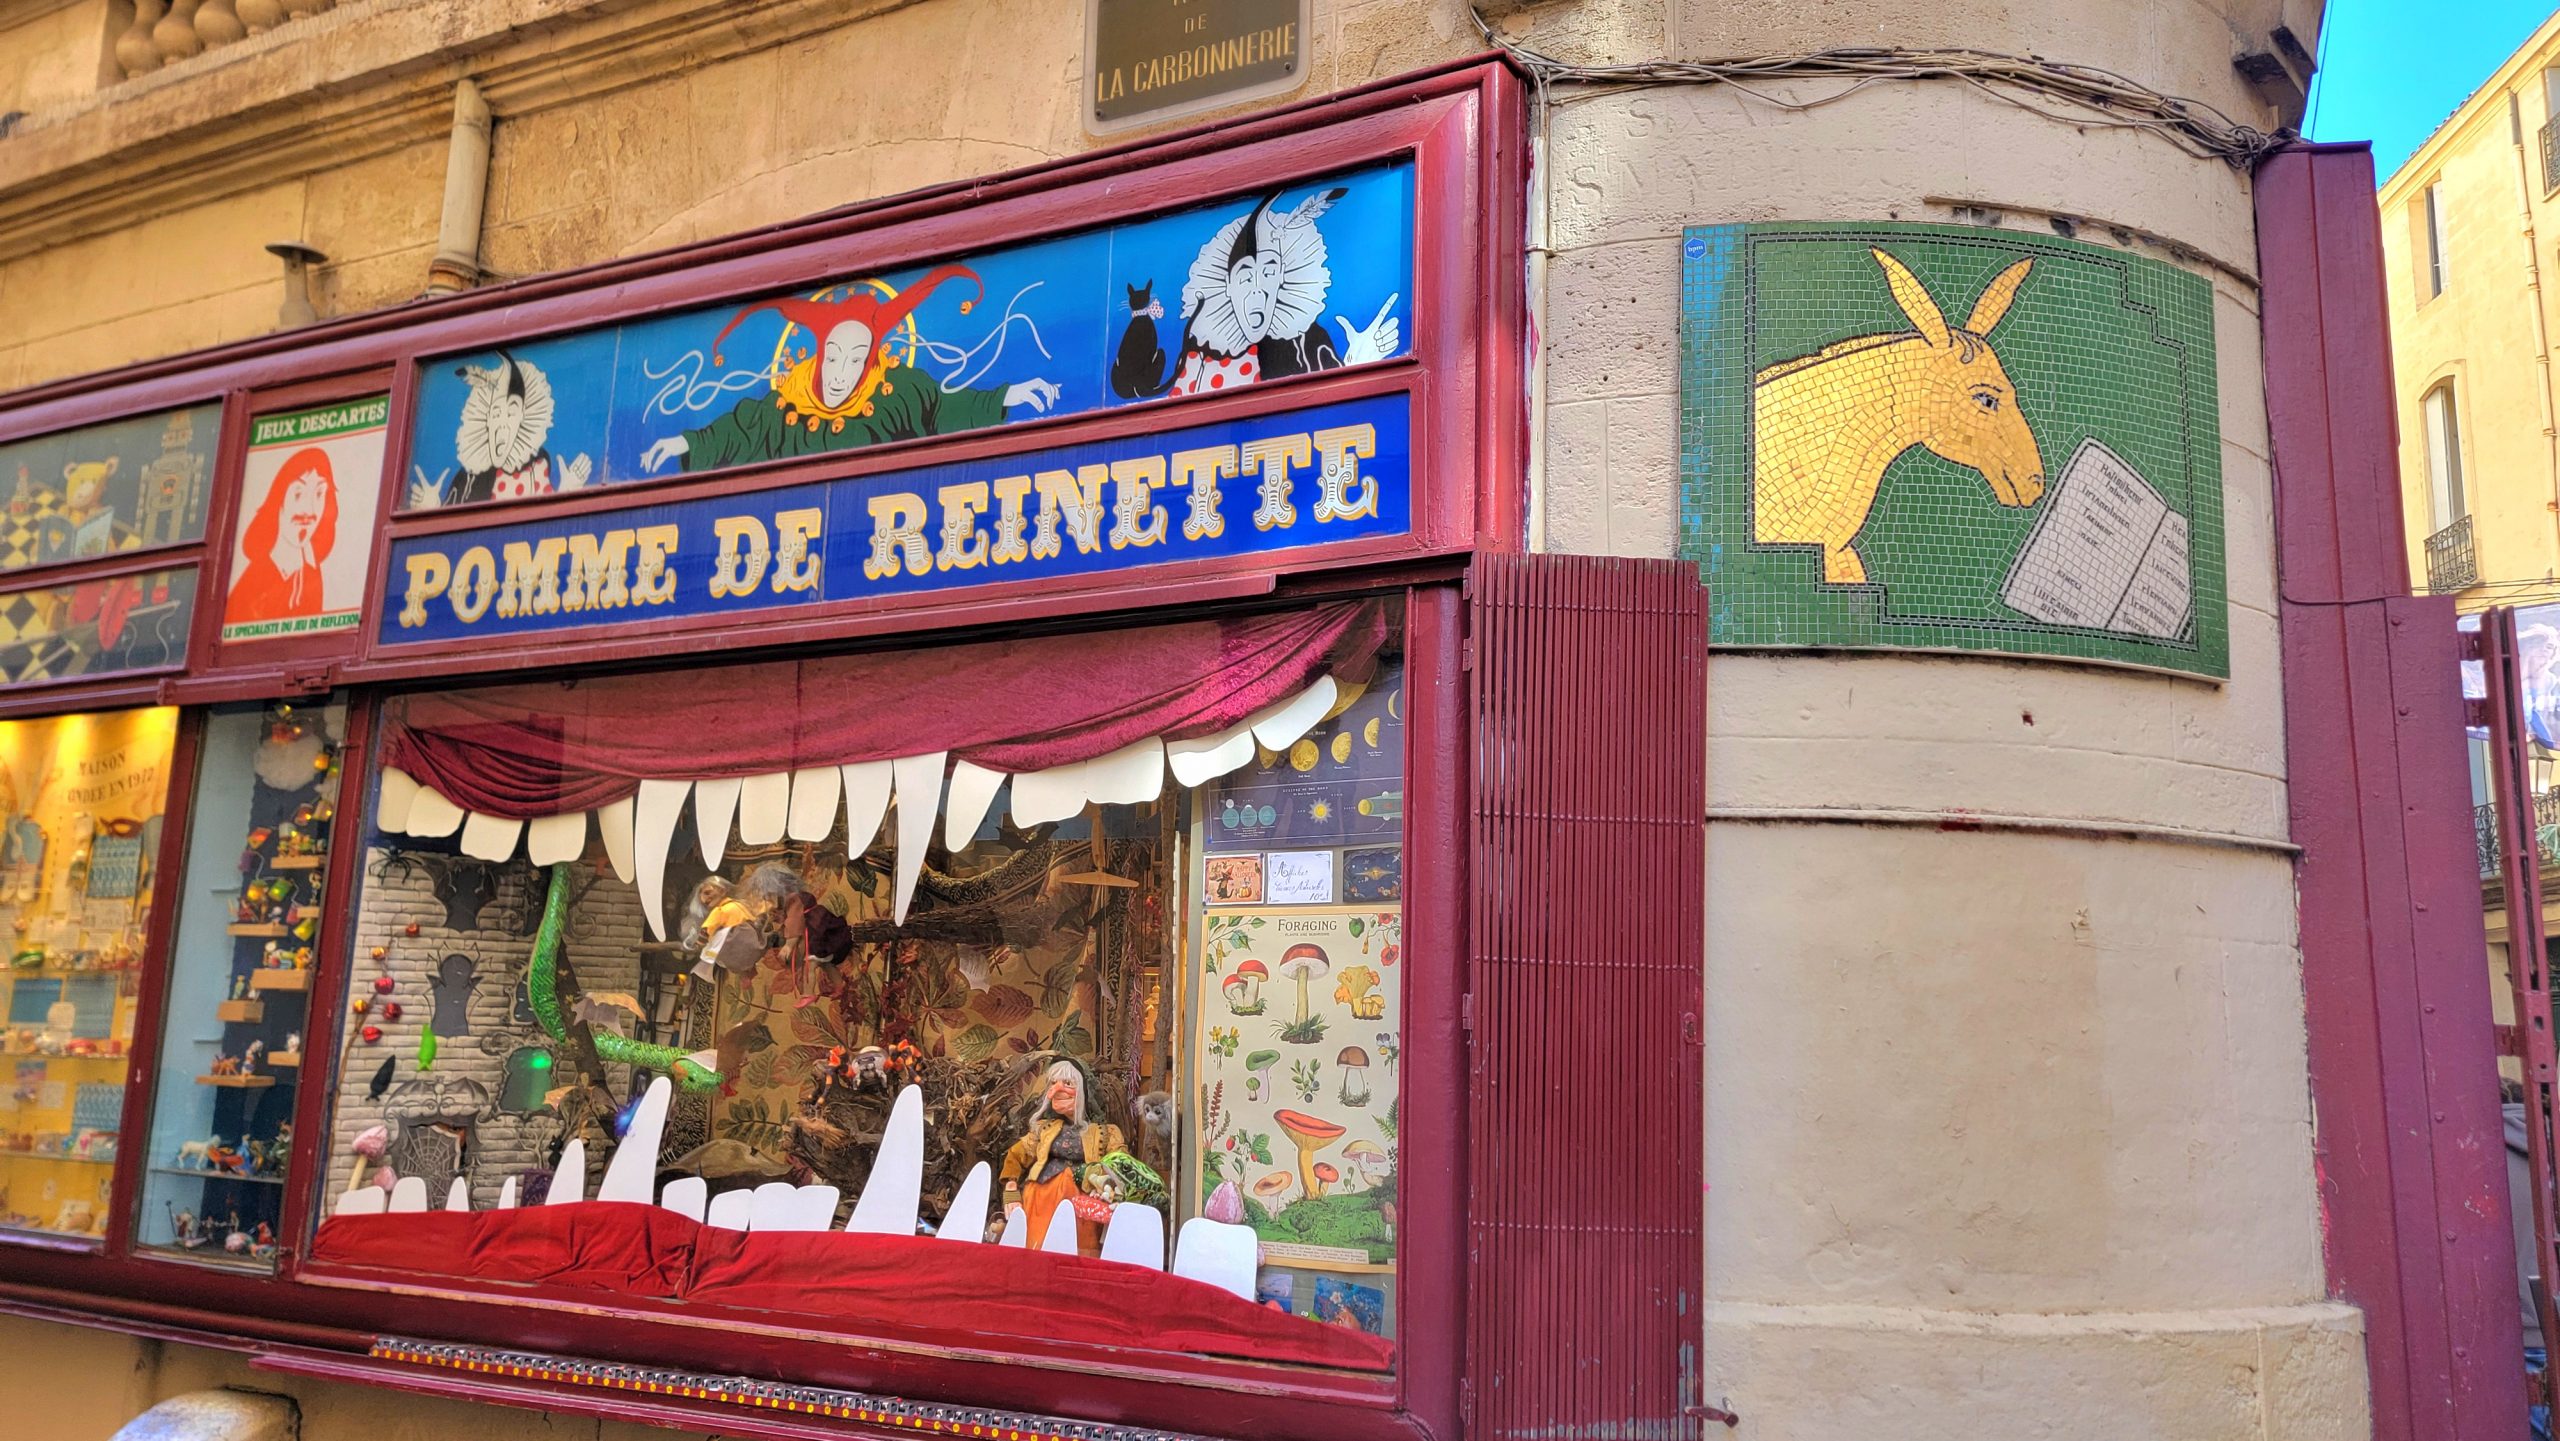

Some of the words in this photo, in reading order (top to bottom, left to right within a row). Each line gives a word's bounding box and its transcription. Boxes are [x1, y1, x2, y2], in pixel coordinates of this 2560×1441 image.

[1184, 13, 1207, 34] DE
[1097, 69, 1124, 103] LA
[1133, 22, 1296, 92] CARBONNERIE
[254, 418, 296, 445] JEUX
[299, 401, 386, 433] DESCARTES
[399, 524, 679, 629] POMME
[709, 507, 822, 598] DE
[863, 422, 1379, 580] REINETTE
[223, 627, 233, 638] LE
[234, 623, 280, 637] SPECIALISTE
[281, 622, 292, 632] DU
[293, 619, 307, 630] JEU
[309, 617, 319, 629] DE
[79, 750, 126, 777] MAISON
[109, 779, 125, 797] EN
